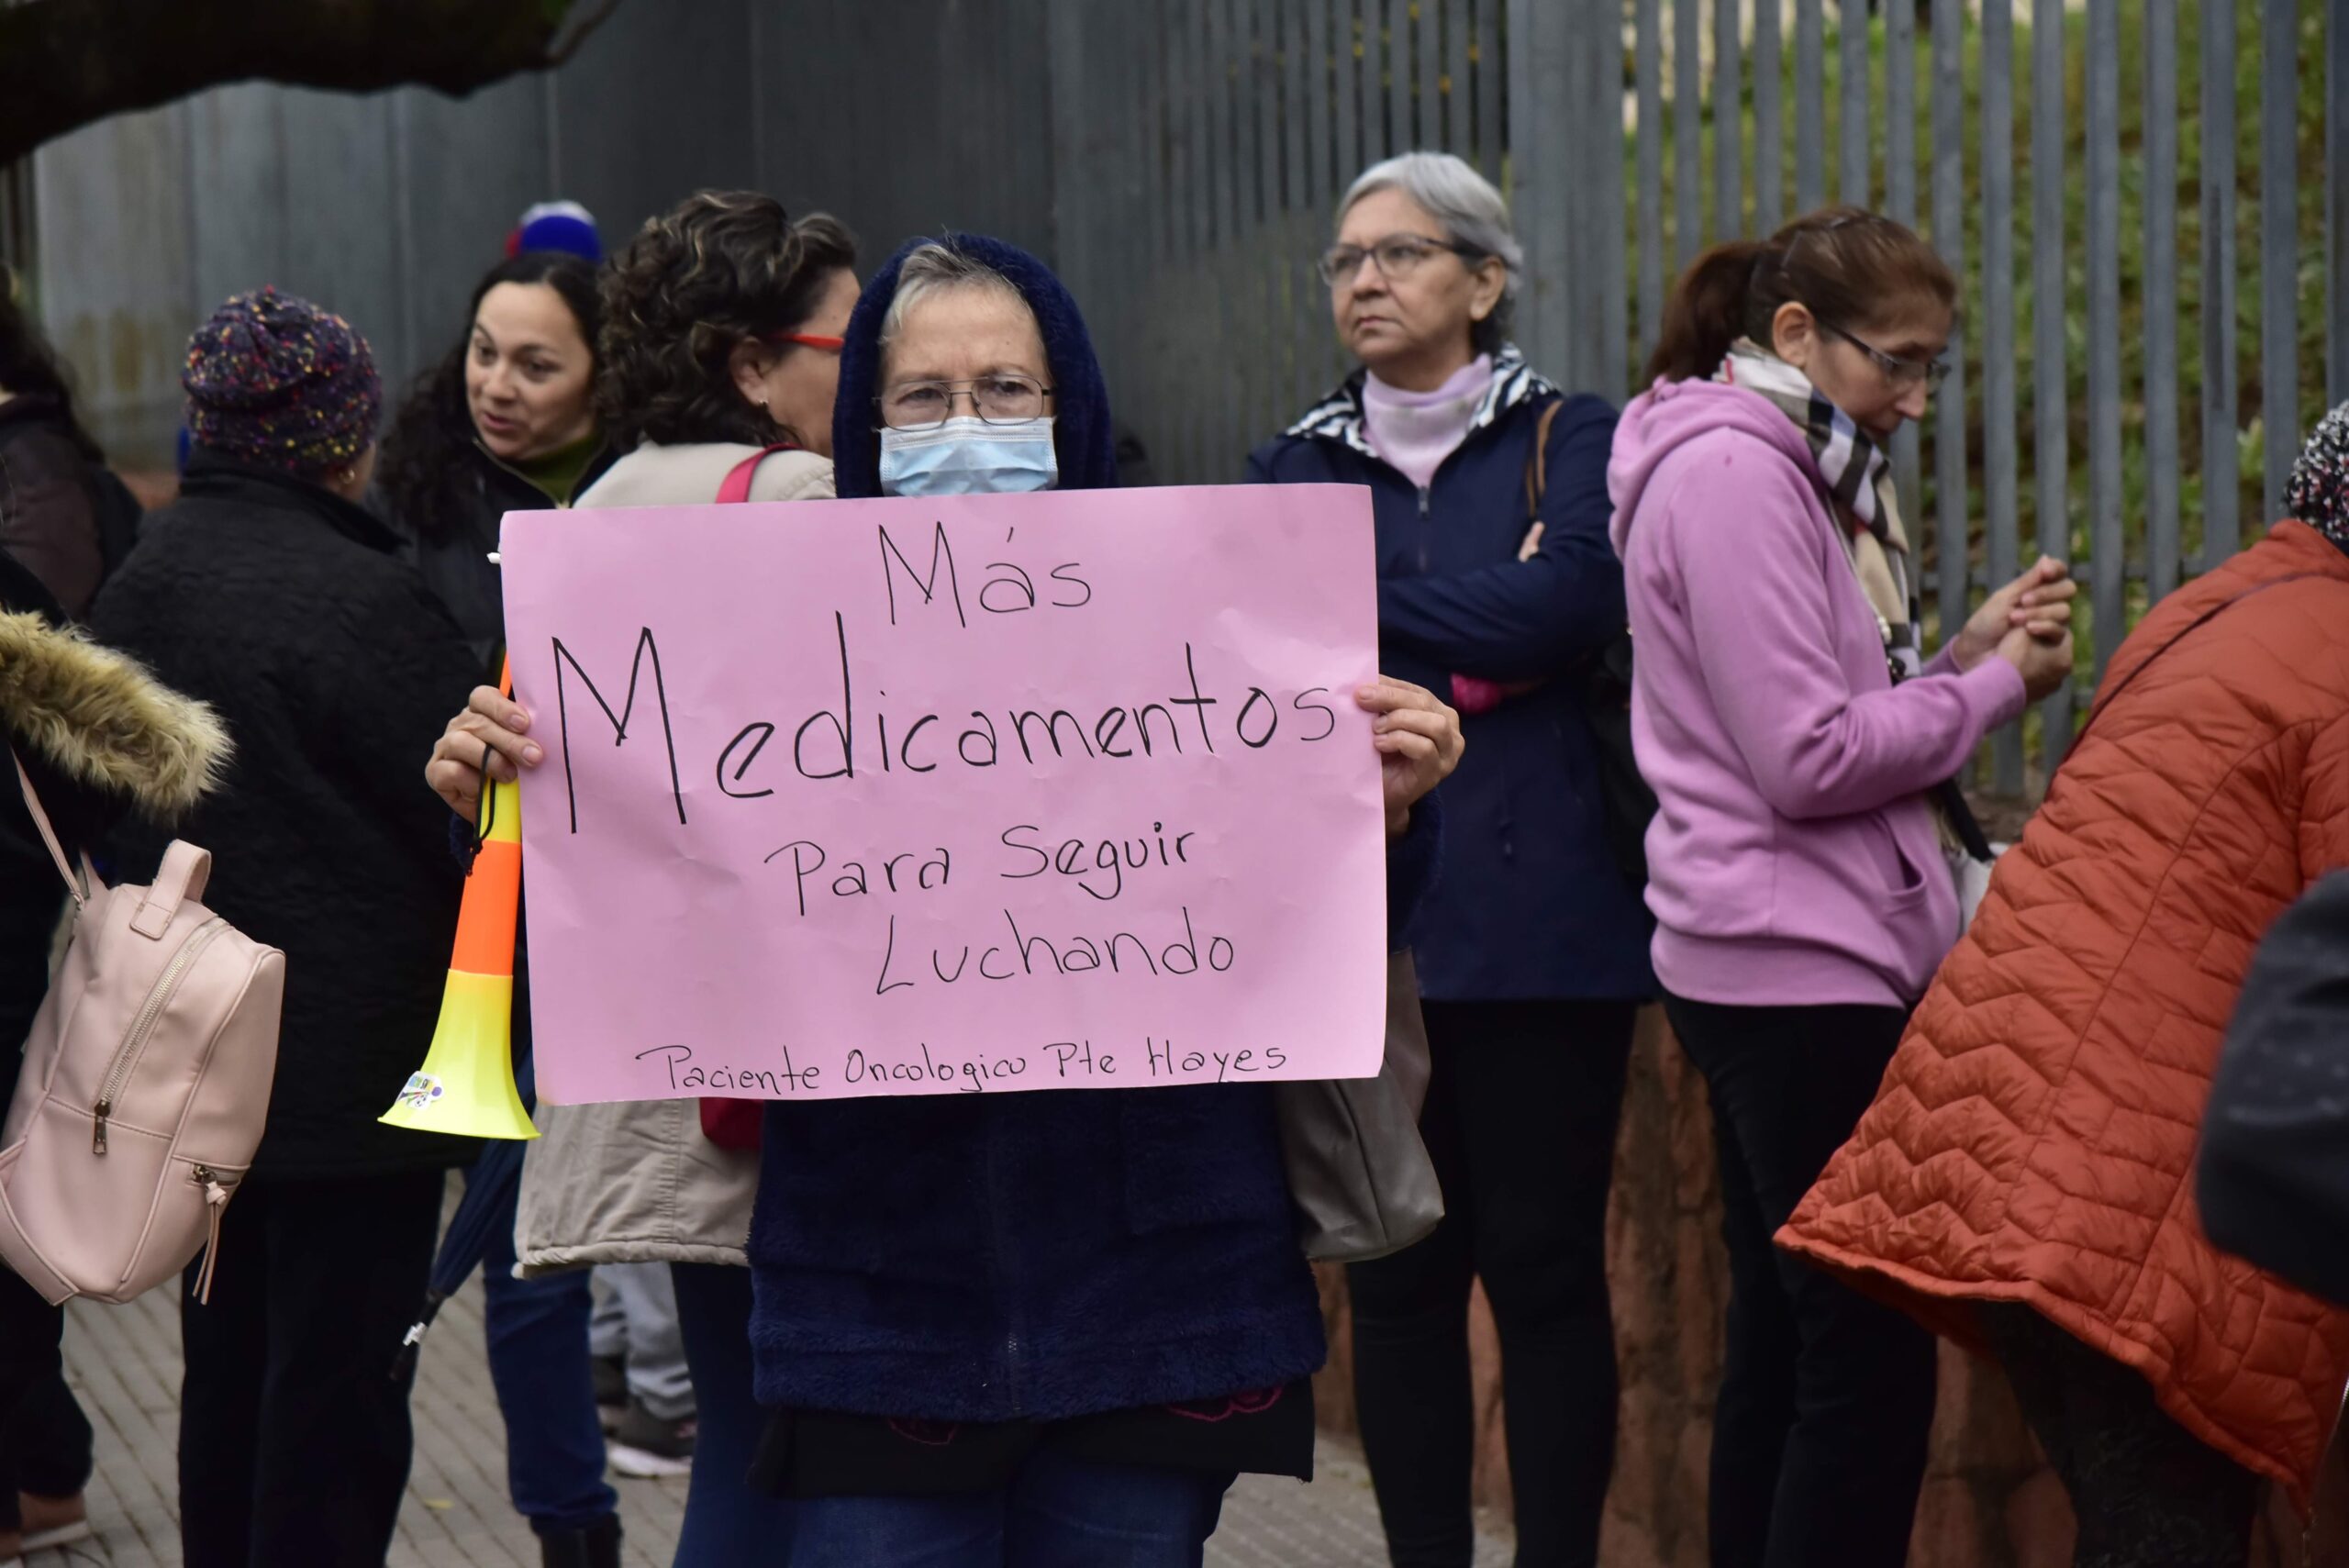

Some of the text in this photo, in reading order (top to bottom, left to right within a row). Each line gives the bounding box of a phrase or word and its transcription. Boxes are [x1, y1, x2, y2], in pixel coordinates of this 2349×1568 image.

[878, 520, 1092, 628] Más
[551, 610, 1335, 834] Medicamentos
[763, 822, 1195, 917] Para Seguir
[875, 906, 1234, 995] Luchando
[635, 1037, 1286, 1095] Paciente Oncologico Pte Hayes
